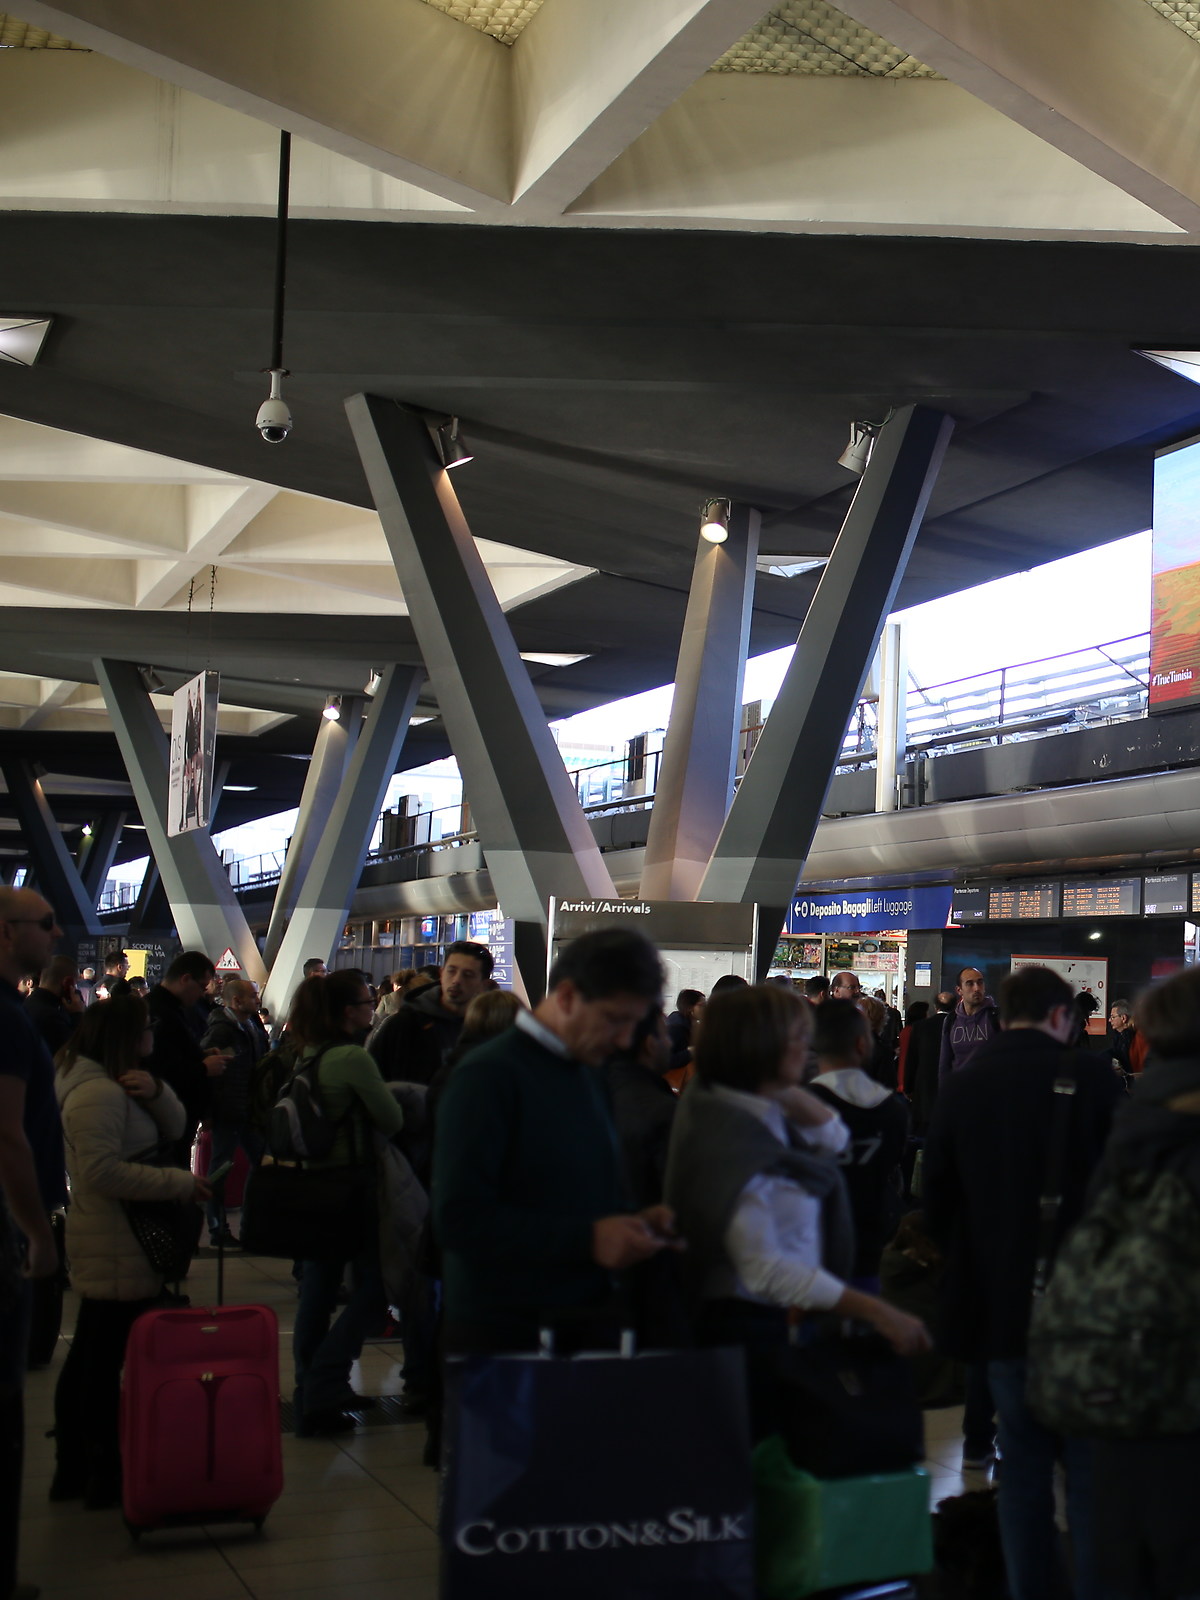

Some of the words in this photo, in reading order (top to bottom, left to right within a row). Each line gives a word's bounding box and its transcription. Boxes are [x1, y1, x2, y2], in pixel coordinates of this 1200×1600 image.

[560, 900, 651, 914] Arrivi/Arrivals
[810, 901, 842, 920] Deposito
[842, 898, 871, 918] Bagagli
[872, 900, 882, 914] Left
[884, 900, 912, 916] Luggage
